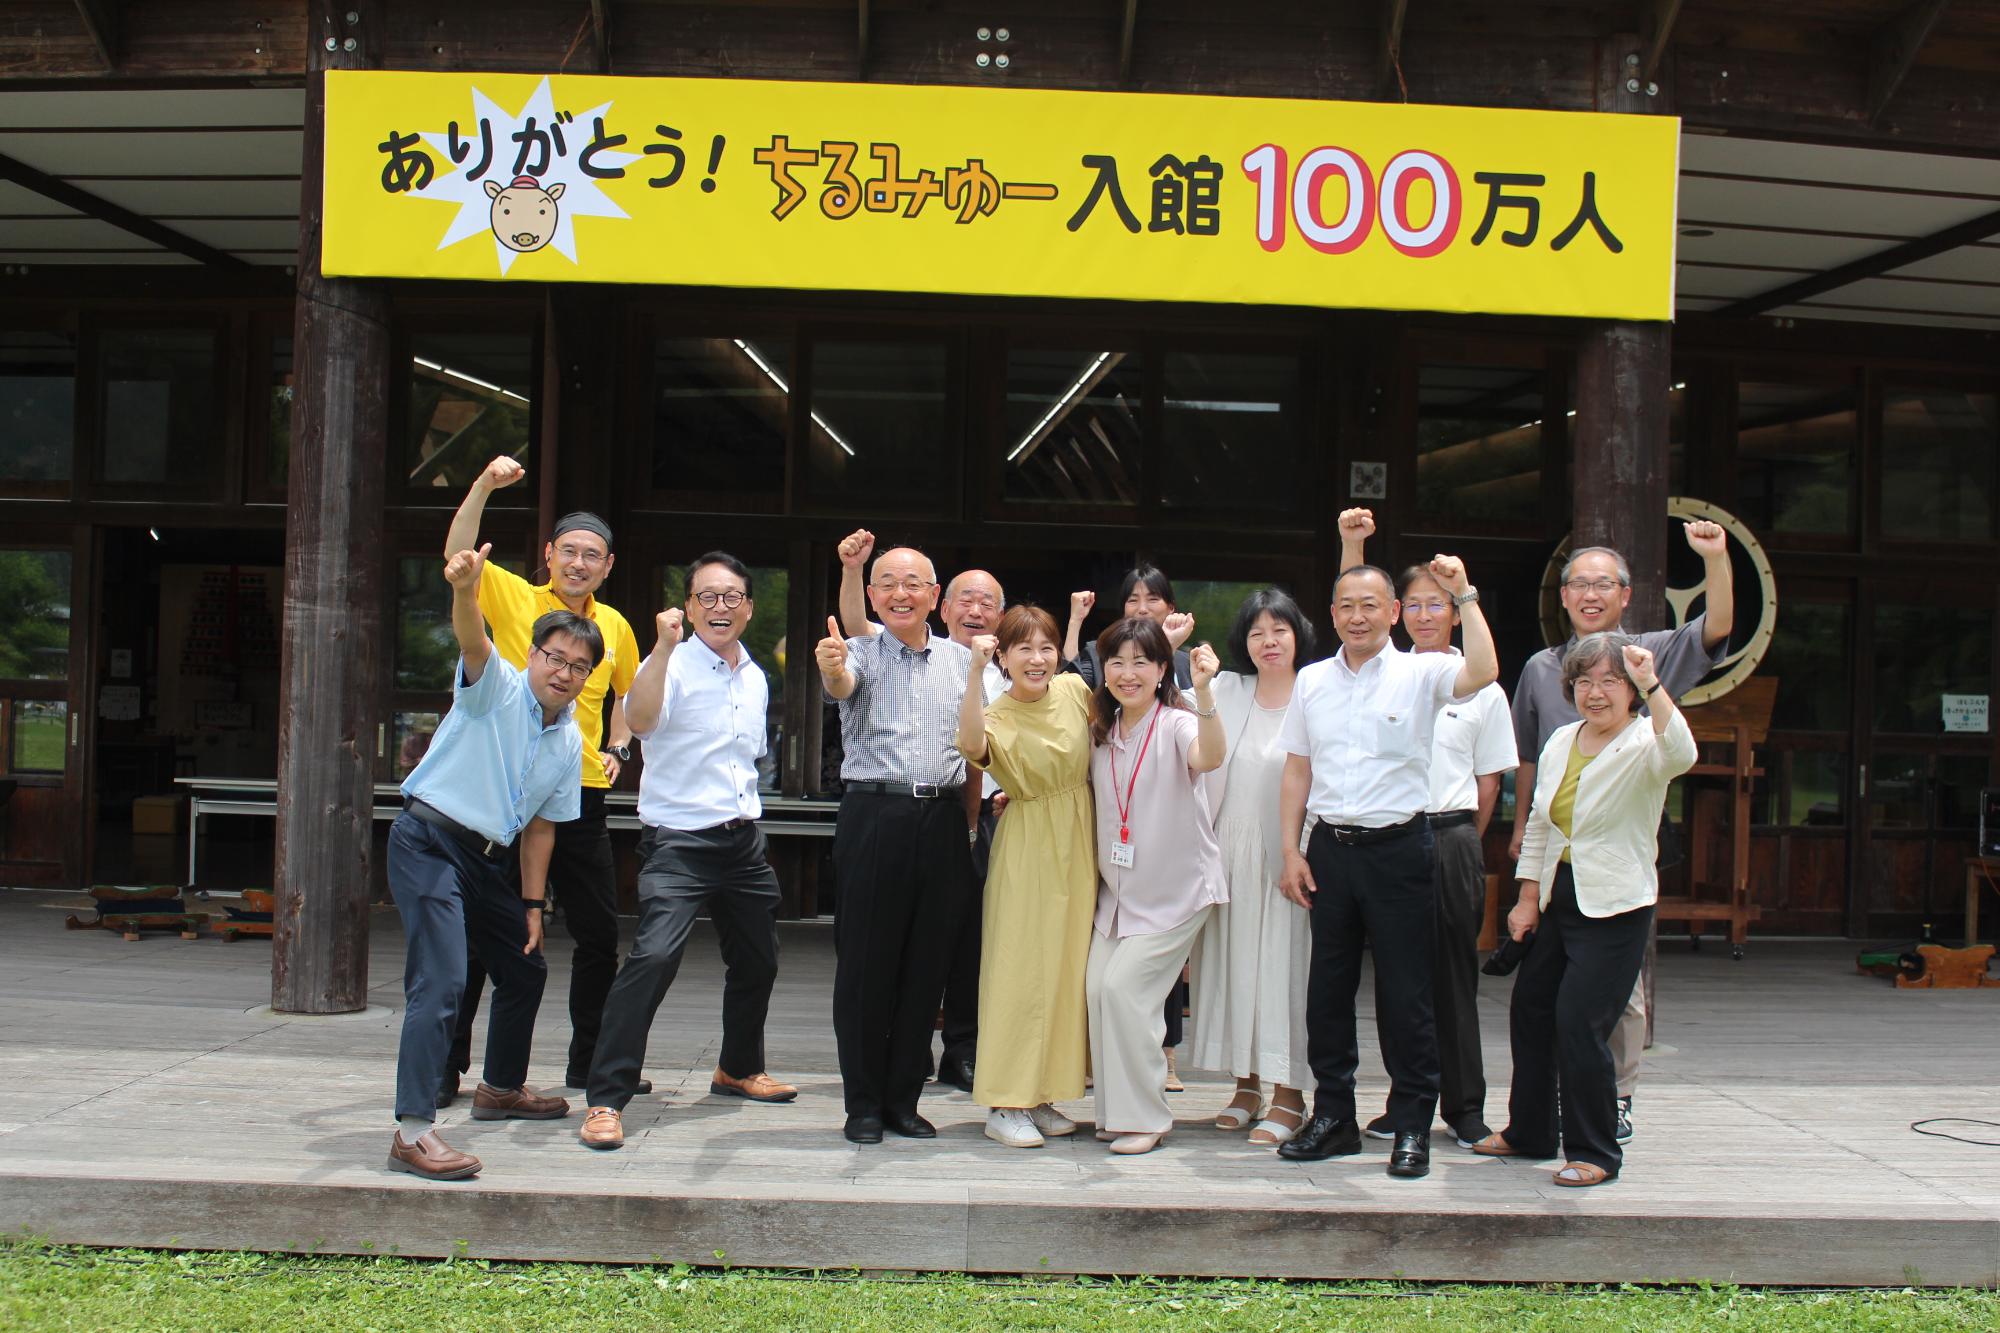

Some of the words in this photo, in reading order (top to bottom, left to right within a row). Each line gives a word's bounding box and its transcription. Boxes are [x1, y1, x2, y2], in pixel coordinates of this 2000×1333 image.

[378, 111, 726, 193] ありがとう！
